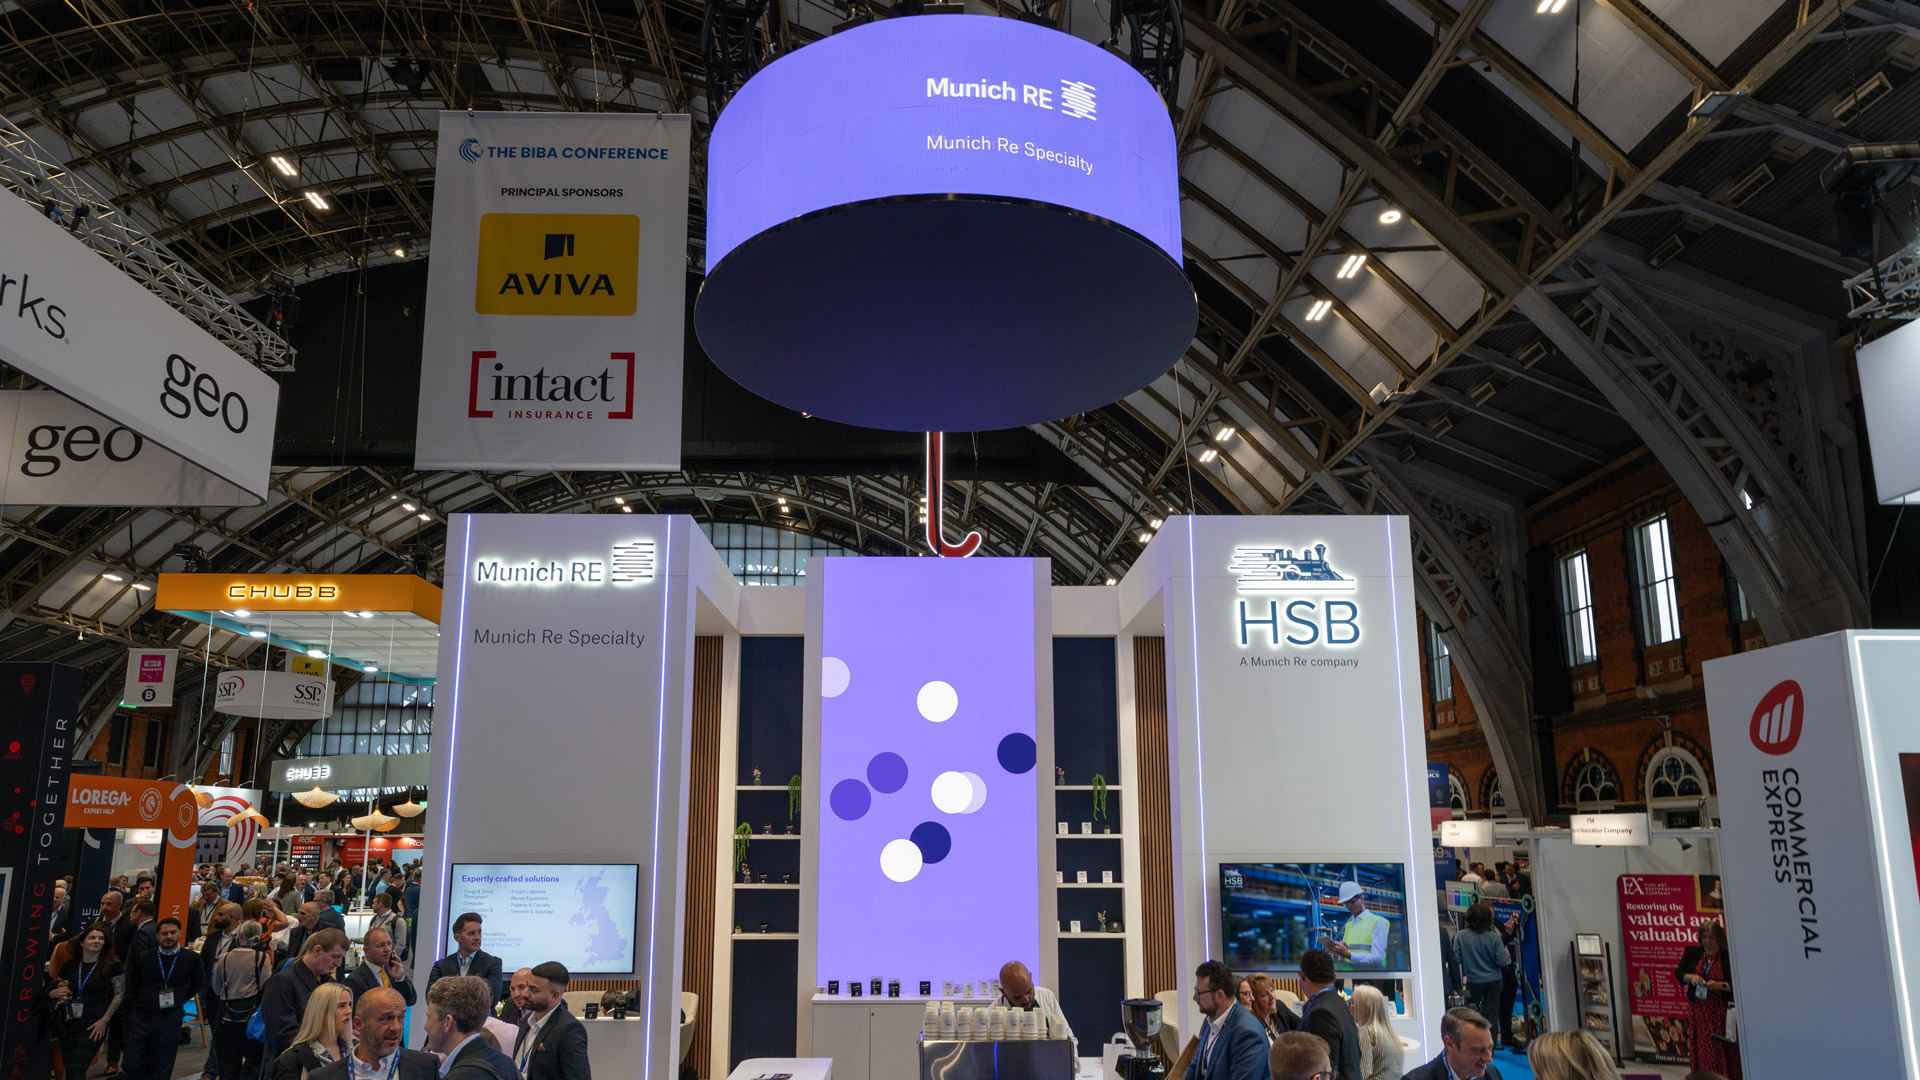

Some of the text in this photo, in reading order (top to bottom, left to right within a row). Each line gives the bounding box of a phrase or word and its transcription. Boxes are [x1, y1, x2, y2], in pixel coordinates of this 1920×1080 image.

[926, 77, 1053, 110] Munich RE
[487, 146, 669, 161] THE BIBA CONFERENCE
[927, 135, 1094, 176] Munich Re Specialty
[500, 187, 624, 198] PRINCIPAL SPONSORS
[498, 273, 615, 296] AVIVA
[490, 362, 615, 403] intact
[160, 354, 249, 434] geo
[508, 410, 593, 420] INSURANCE
[21, 424, 143, 477] geo
[477, 561, 602, 582] Munich RE
[229, 585, 337, 599] CHUBB
[1239, 600, 1360, 646] HSB
[474, 628, 645, 648] Munich Re Specialty
[1239, 656, 1359, 669] A Munich Re company
[145, 690, 154, 700] B
[286, 766, 330, 781] CHUBB
[37, 718, 68, 866] TOGETHER
[72, 788, 131, 806] LOREGA
[1762, 769, 1791, 884] EXPRESS
[1782, 767, 1821, 959] COMMERCIAL
[461, 875, 559, 883] Expertly crafted solutions
[1224, 877, 1243, 885] HSB
[1626, 902, 1684, 912] Restoring the
[1627, 912, 1686, 927] valued
[17, 883, 45, 1023] GROWING
